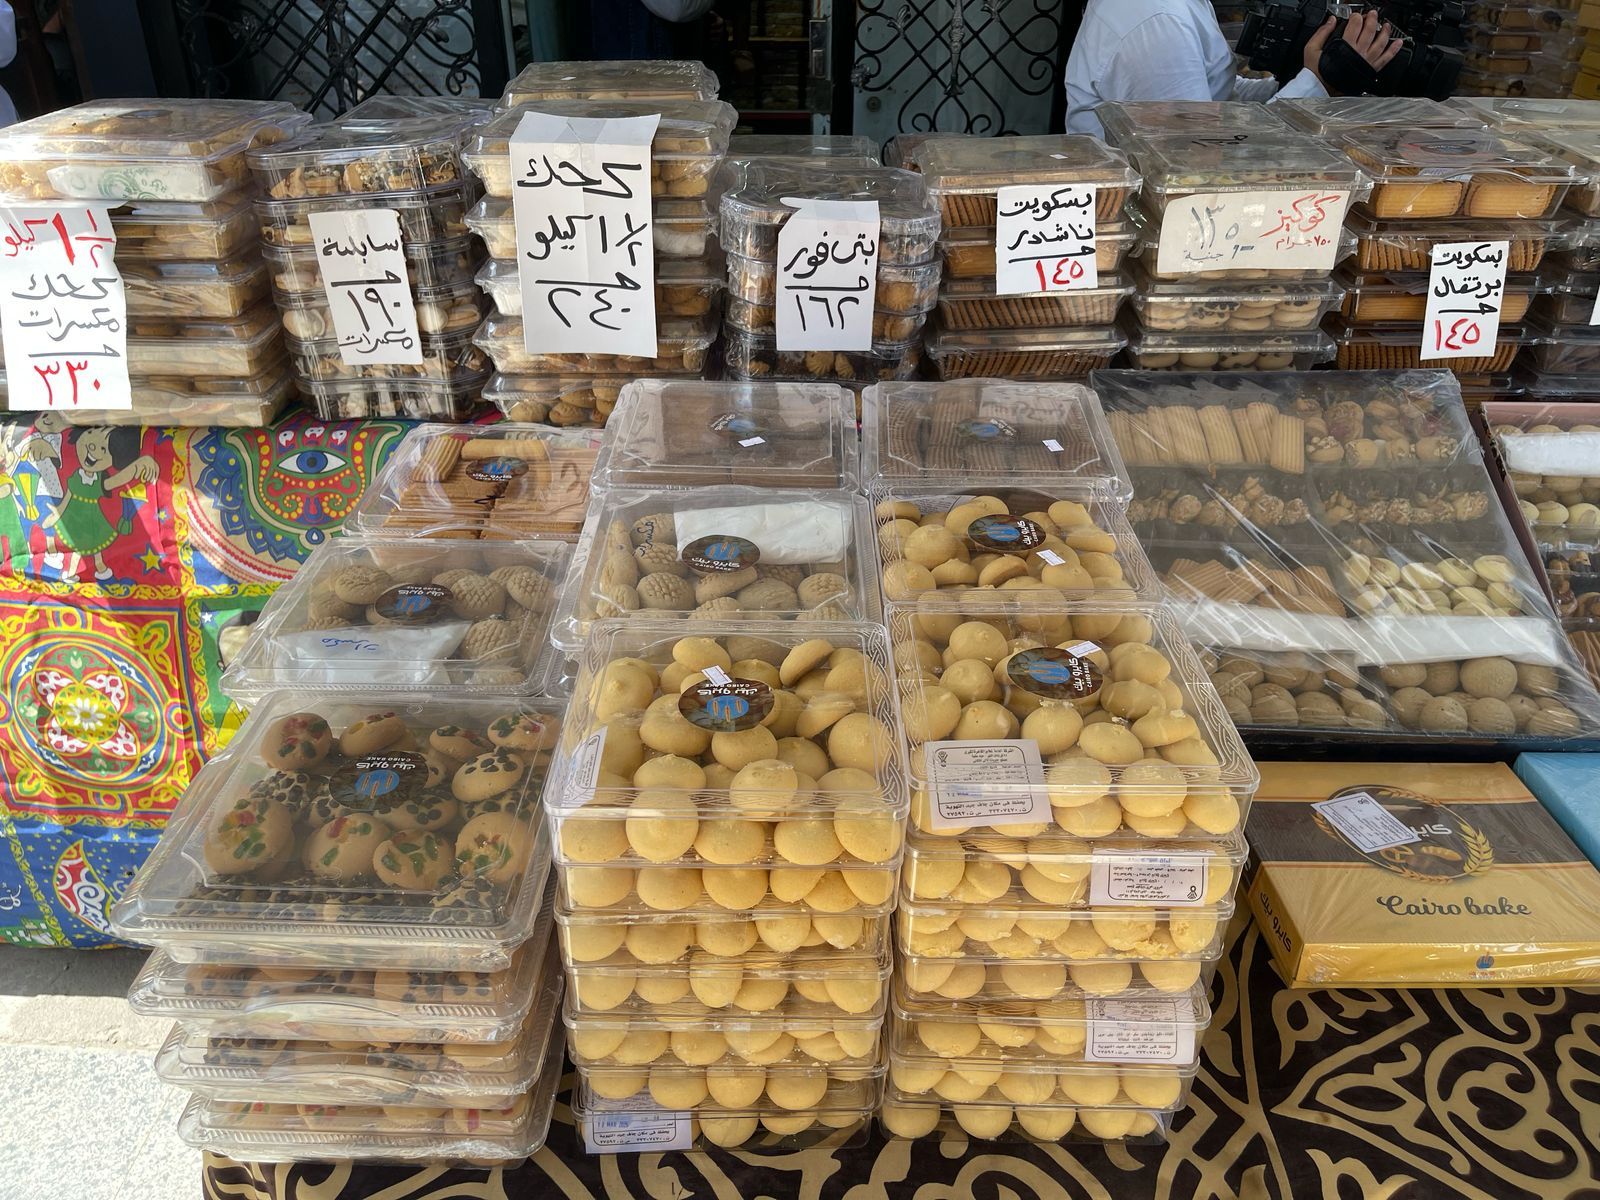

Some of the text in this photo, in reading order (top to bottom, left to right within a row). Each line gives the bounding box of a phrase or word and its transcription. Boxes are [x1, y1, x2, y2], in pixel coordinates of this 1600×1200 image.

[517, 154, 642, 199] كحك
[999, 187, 1093, 222] بسكويت
[1259, 192, 1341, 238] كوكيز
[4, 219, 48, 257] كيلو
[527, 214, 594, 261] كيلو
[783, 231, 830, 279] فور
[1313, 235, 1331, 247] ٧٥٠
[1433, 243, 1503, 270] بسكويت
[11, 273, 118, 301] كحك
[1035, 257, 1084, 292] ١٤٥
[1434, 275, 1502, 299] برتقال
[18, 307, 120, 342] مكسرات
[346, 287, 401, 332] ١٩٠
[795, 294, 860, 332] ١٦٢
[338, 327, 414, 354] مكسرات
[1434, 317, 1481, 351] ١٤٥
[33, 360, 101, 406] ٣٣٠
[696, 687, 731, 697] كايرو
[355, 761, 389, 770] كايرو
[1410, 823, 1452, 837] كاير
[1376, 895, 1532, 916] Cairo bake
